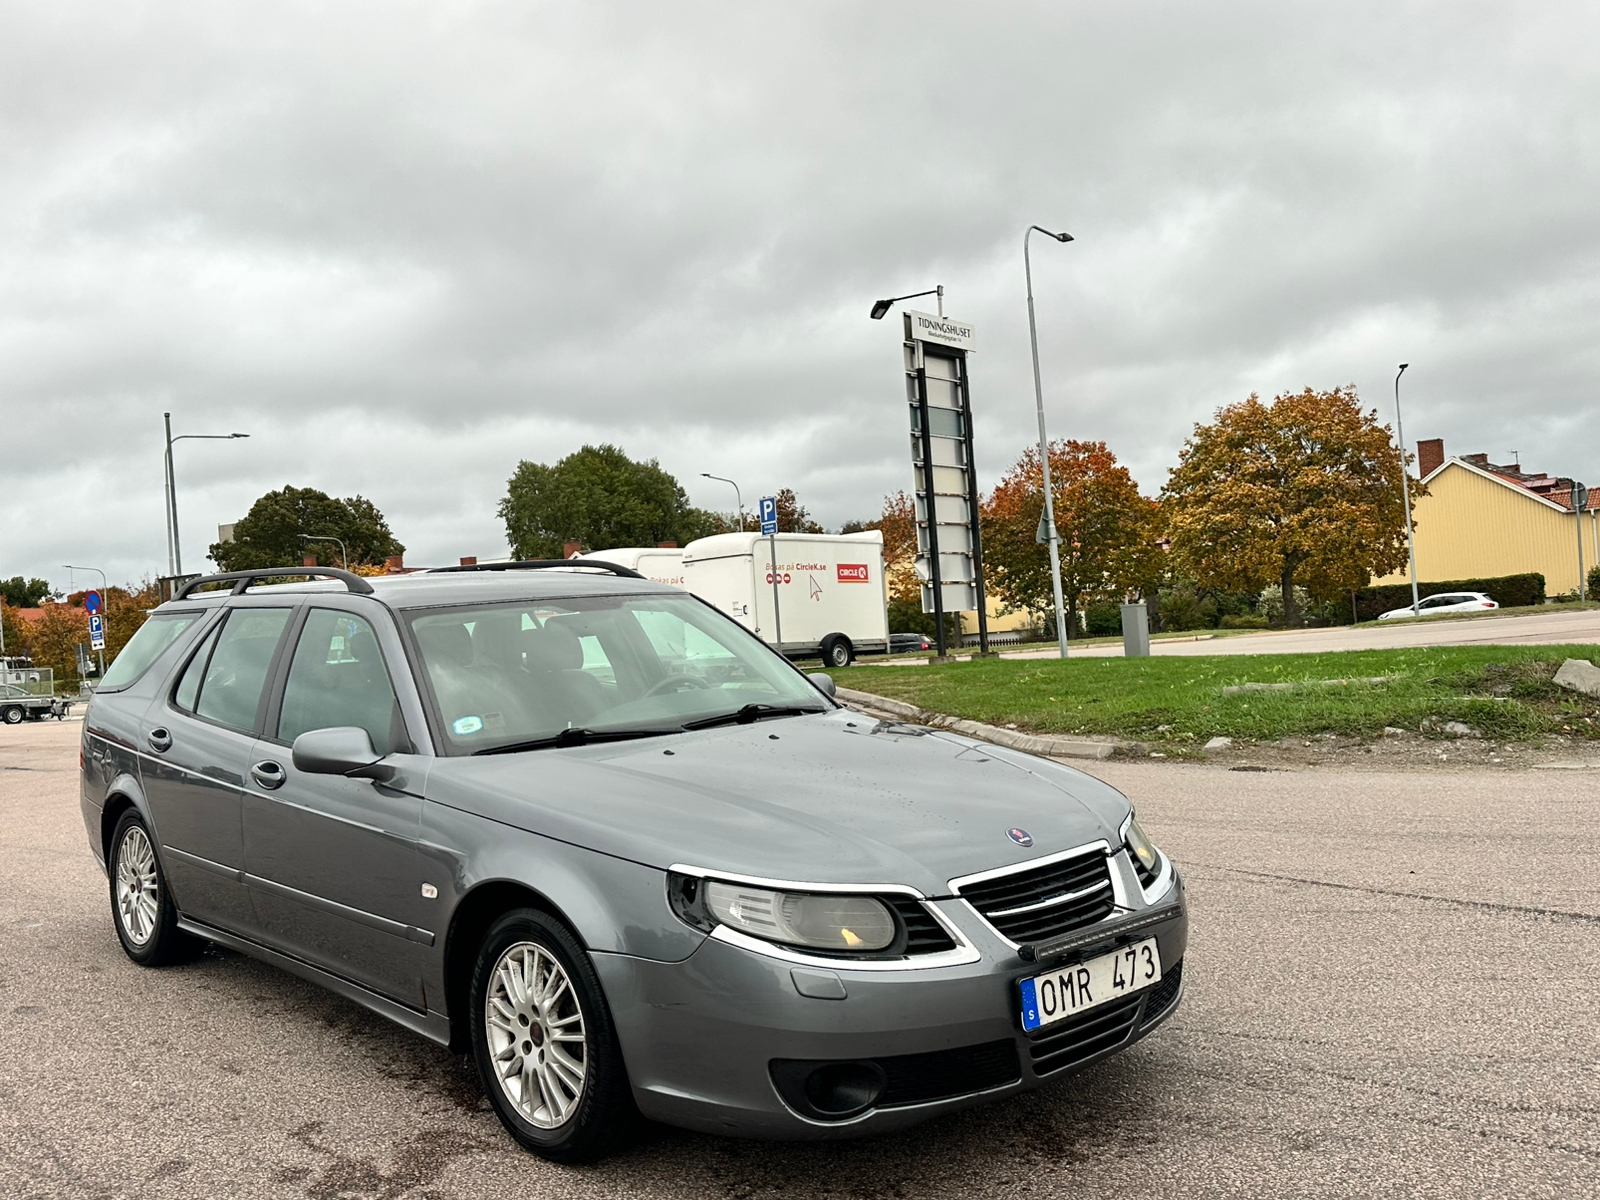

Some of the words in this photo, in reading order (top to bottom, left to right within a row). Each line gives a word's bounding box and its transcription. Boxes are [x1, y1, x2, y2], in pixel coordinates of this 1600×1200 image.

[917, 316, 971, 338] TIDNINGSHUSET
[763, 500, 773, 520] P
[765, 563, 785, 571] Boas
[786, 563, 795, 572] på
[795, 563, 827, 571] CircleK.se
[839, 568, 858, 577] CIRCLE
[859, 567, 867, 578] K
[91, 616, 100, 631] P
[1040, 967, 1093, 1016] OMR
[1113, 945, 1156, 990] 473
[1028, 1009, 1035, 1020] S
